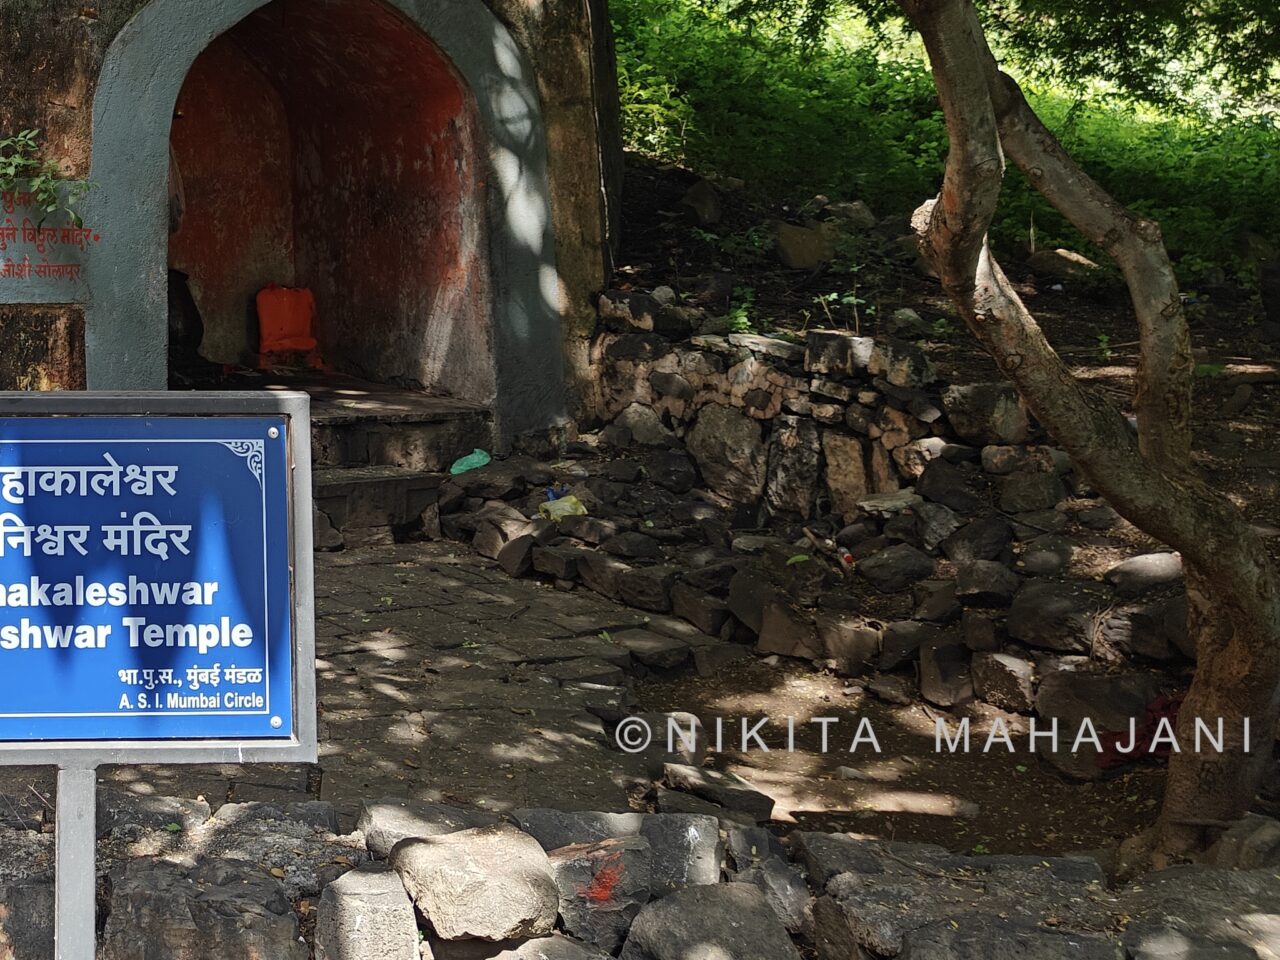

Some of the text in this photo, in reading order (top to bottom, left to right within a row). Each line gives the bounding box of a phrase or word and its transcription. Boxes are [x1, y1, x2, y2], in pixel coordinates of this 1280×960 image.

[101, 511, 192, 561] मंदिर
[122, 616, 254, 654] Temple
[185, 663, 221, 690] मुंबई
[223, 664, 263, 685] मंडळ
[118, 693, 134, 709] A.
[137, 693, 151, 709] S.
[166, 691, 221, 709] Mumbai
[223, 691, 264, 708] Circle
